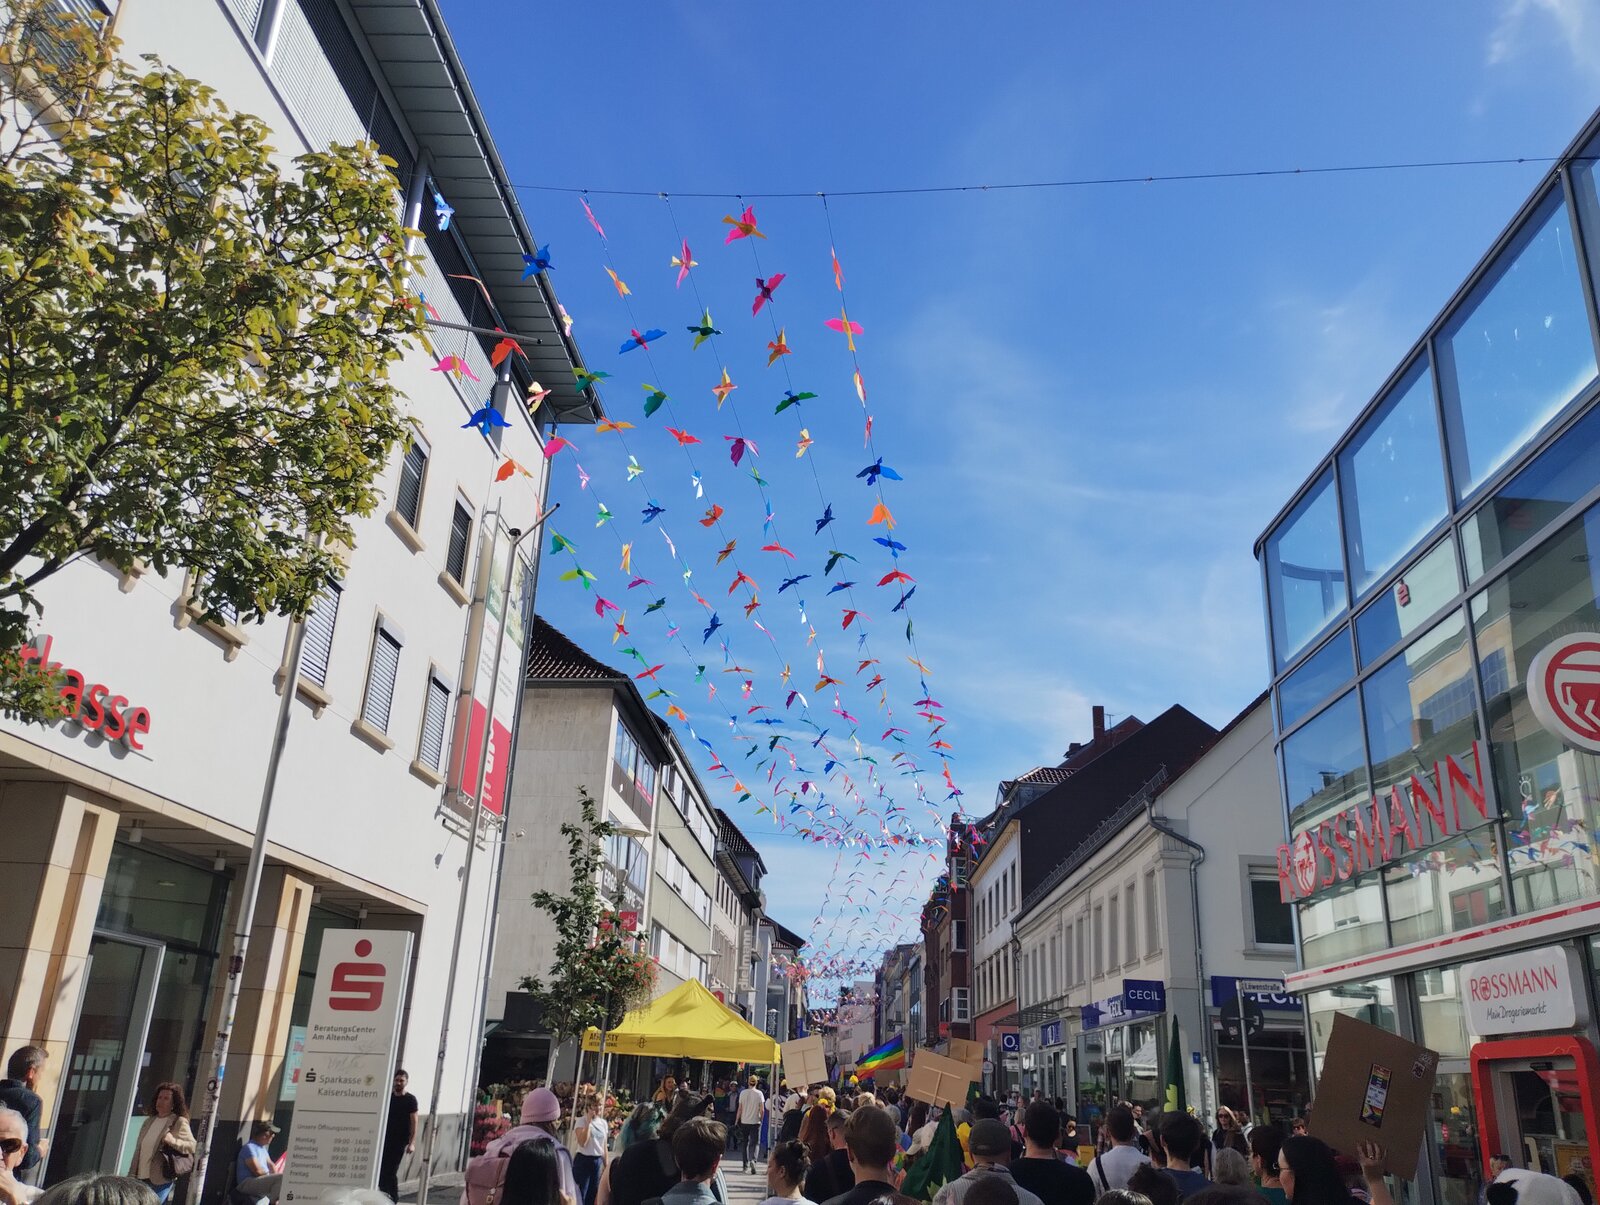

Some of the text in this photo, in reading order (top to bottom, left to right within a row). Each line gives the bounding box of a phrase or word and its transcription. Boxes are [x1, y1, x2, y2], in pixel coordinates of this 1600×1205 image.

[1276, 740, 1489, 904] ROSSMANN
[738, 929, 752, 991] dielmann
[1470, 964, 1558, 1002] ROSSMANN
[1128, 989, 1161, 1001] CECIL
[1499, 1001, 1547, 1024] Drogeriemarkt
[313, 1024, 376, 1033] BeratungsCenter
[326, 1033, 358, 1041] Altenhof
[318, 1075, 362, 1085] Sparkasse
[317, 1088, 378, 1098] Kaiserslautern
